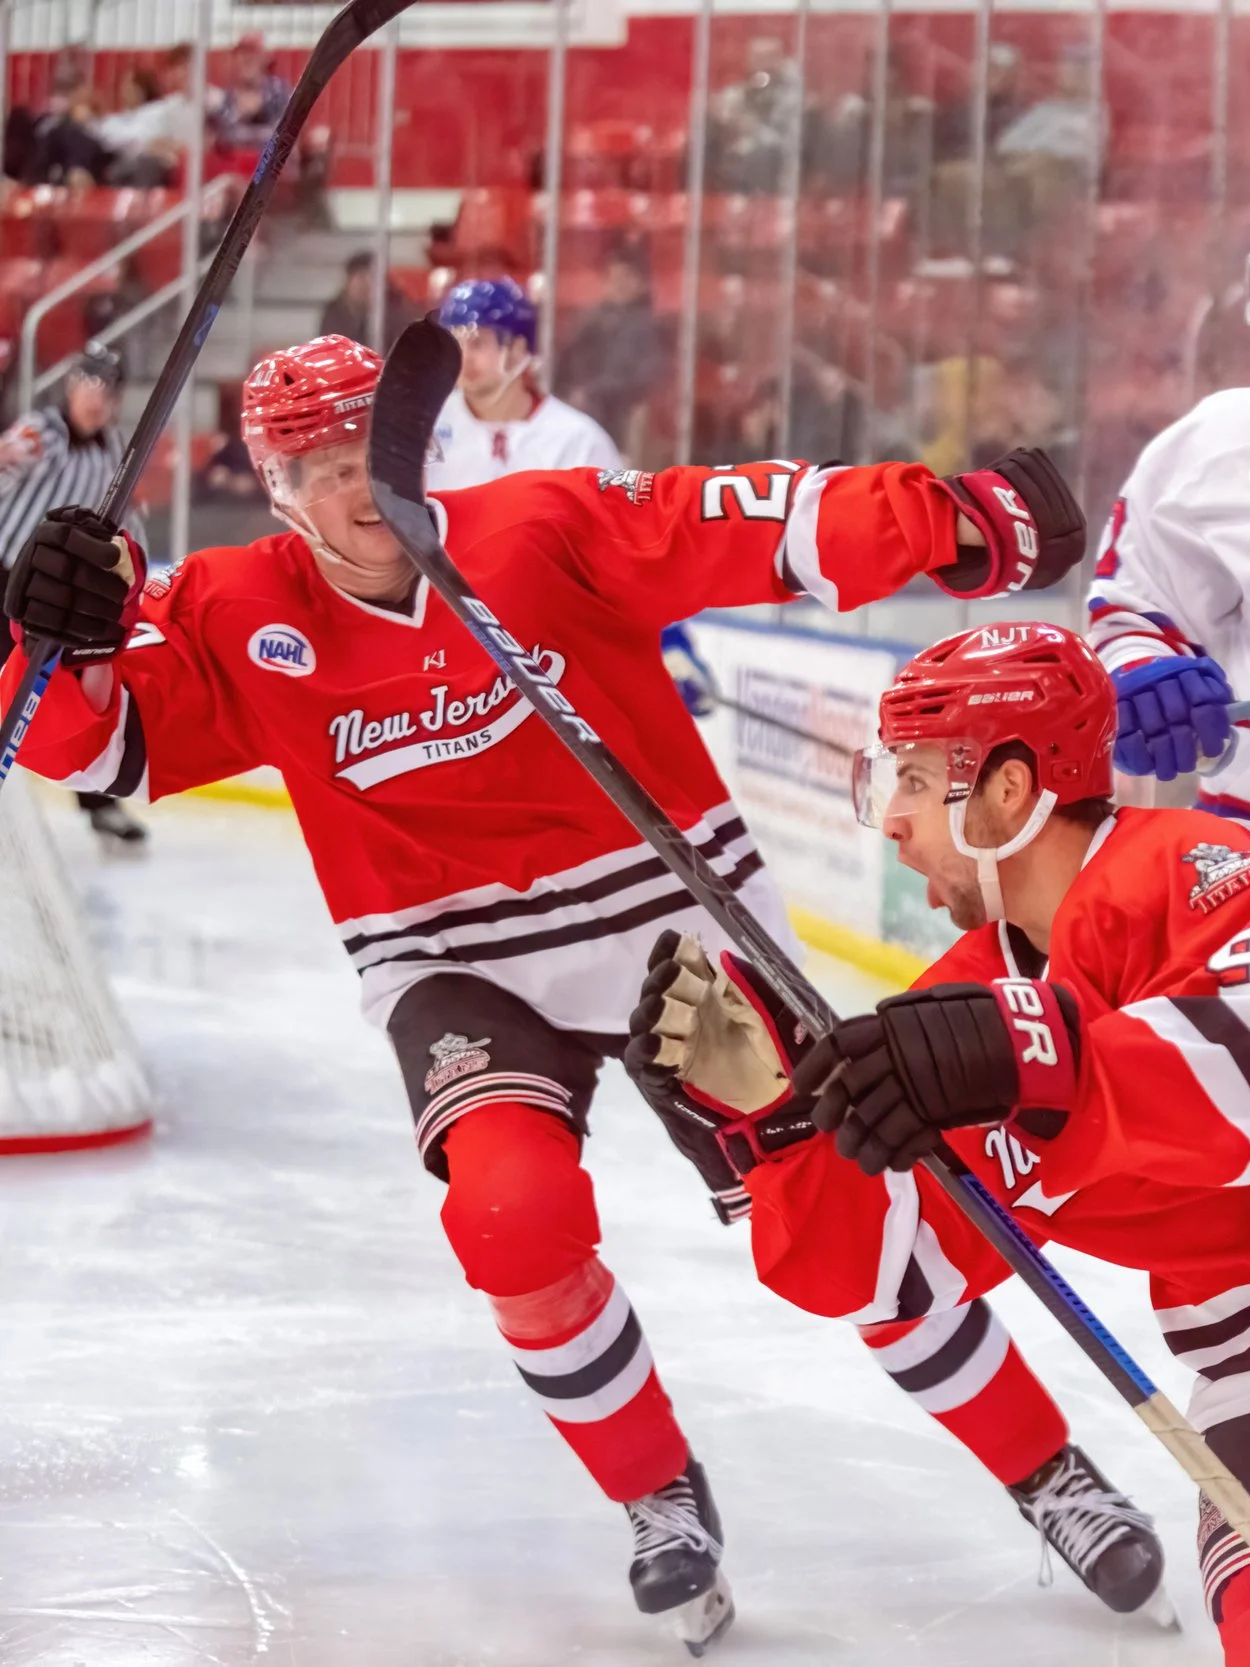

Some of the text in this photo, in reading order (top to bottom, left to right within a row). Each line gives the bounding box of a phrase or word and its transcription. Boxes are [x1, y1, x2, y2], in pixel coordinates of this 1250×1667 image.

[258, 638, 309, 668] NAHL
[980, 626, 1032, 649] NJT
[460, 595, 602, 744] BAUER
[967, 690, 1035, 706] BAUER
[329, 708, 417, 764] New
[422, 728, 493, 761] TITANS
